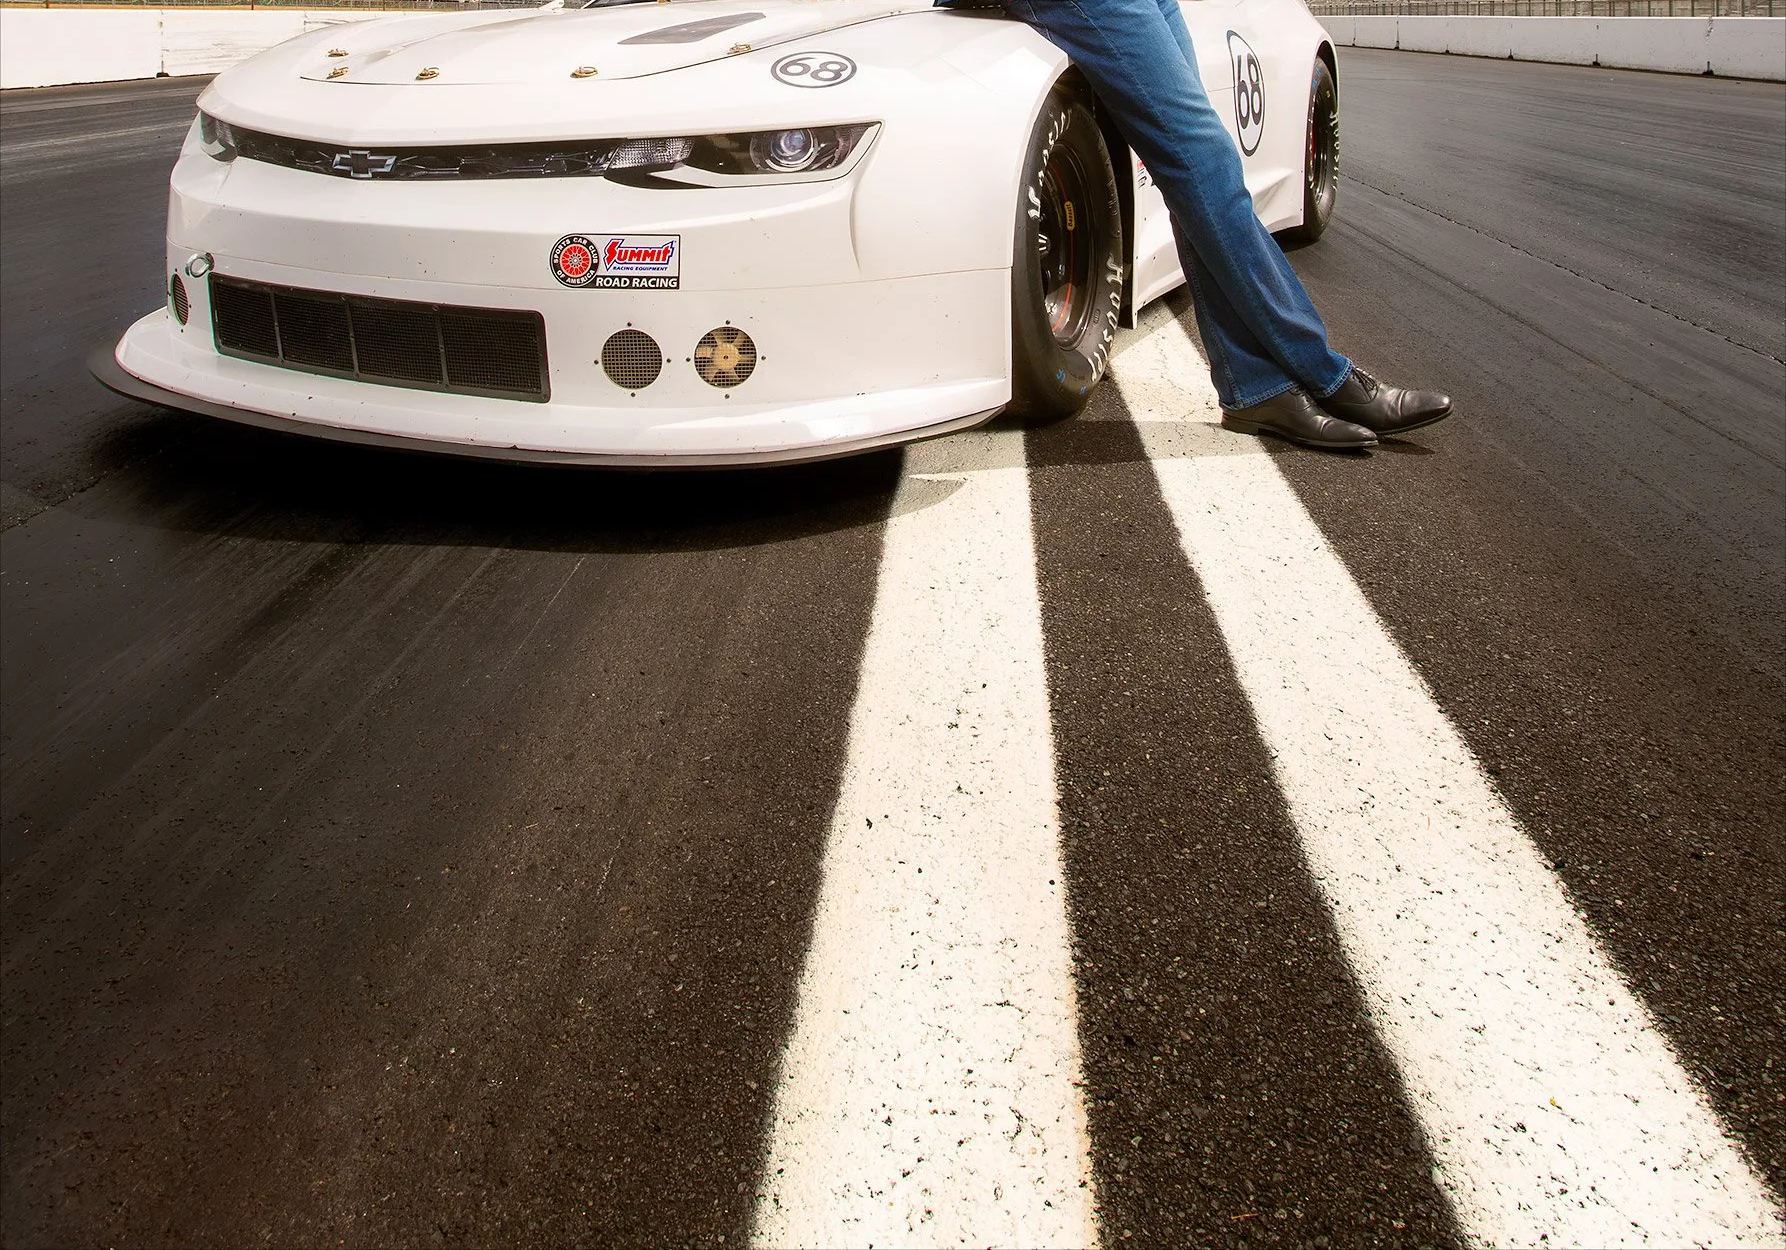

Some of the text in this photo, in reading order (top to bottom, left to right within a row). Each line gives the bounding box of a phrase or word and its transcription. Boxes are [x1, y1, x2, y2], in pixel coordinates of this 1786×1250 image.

[779, 56, 848, 82] 68
[1237, 52, 1262, 130] 68
[553, 237, 598, 264] SPORTS CAR CLUB
[556, 269, 596, 285] OF AMERICA
[596, 277, 677, 288] ROAD RACING
